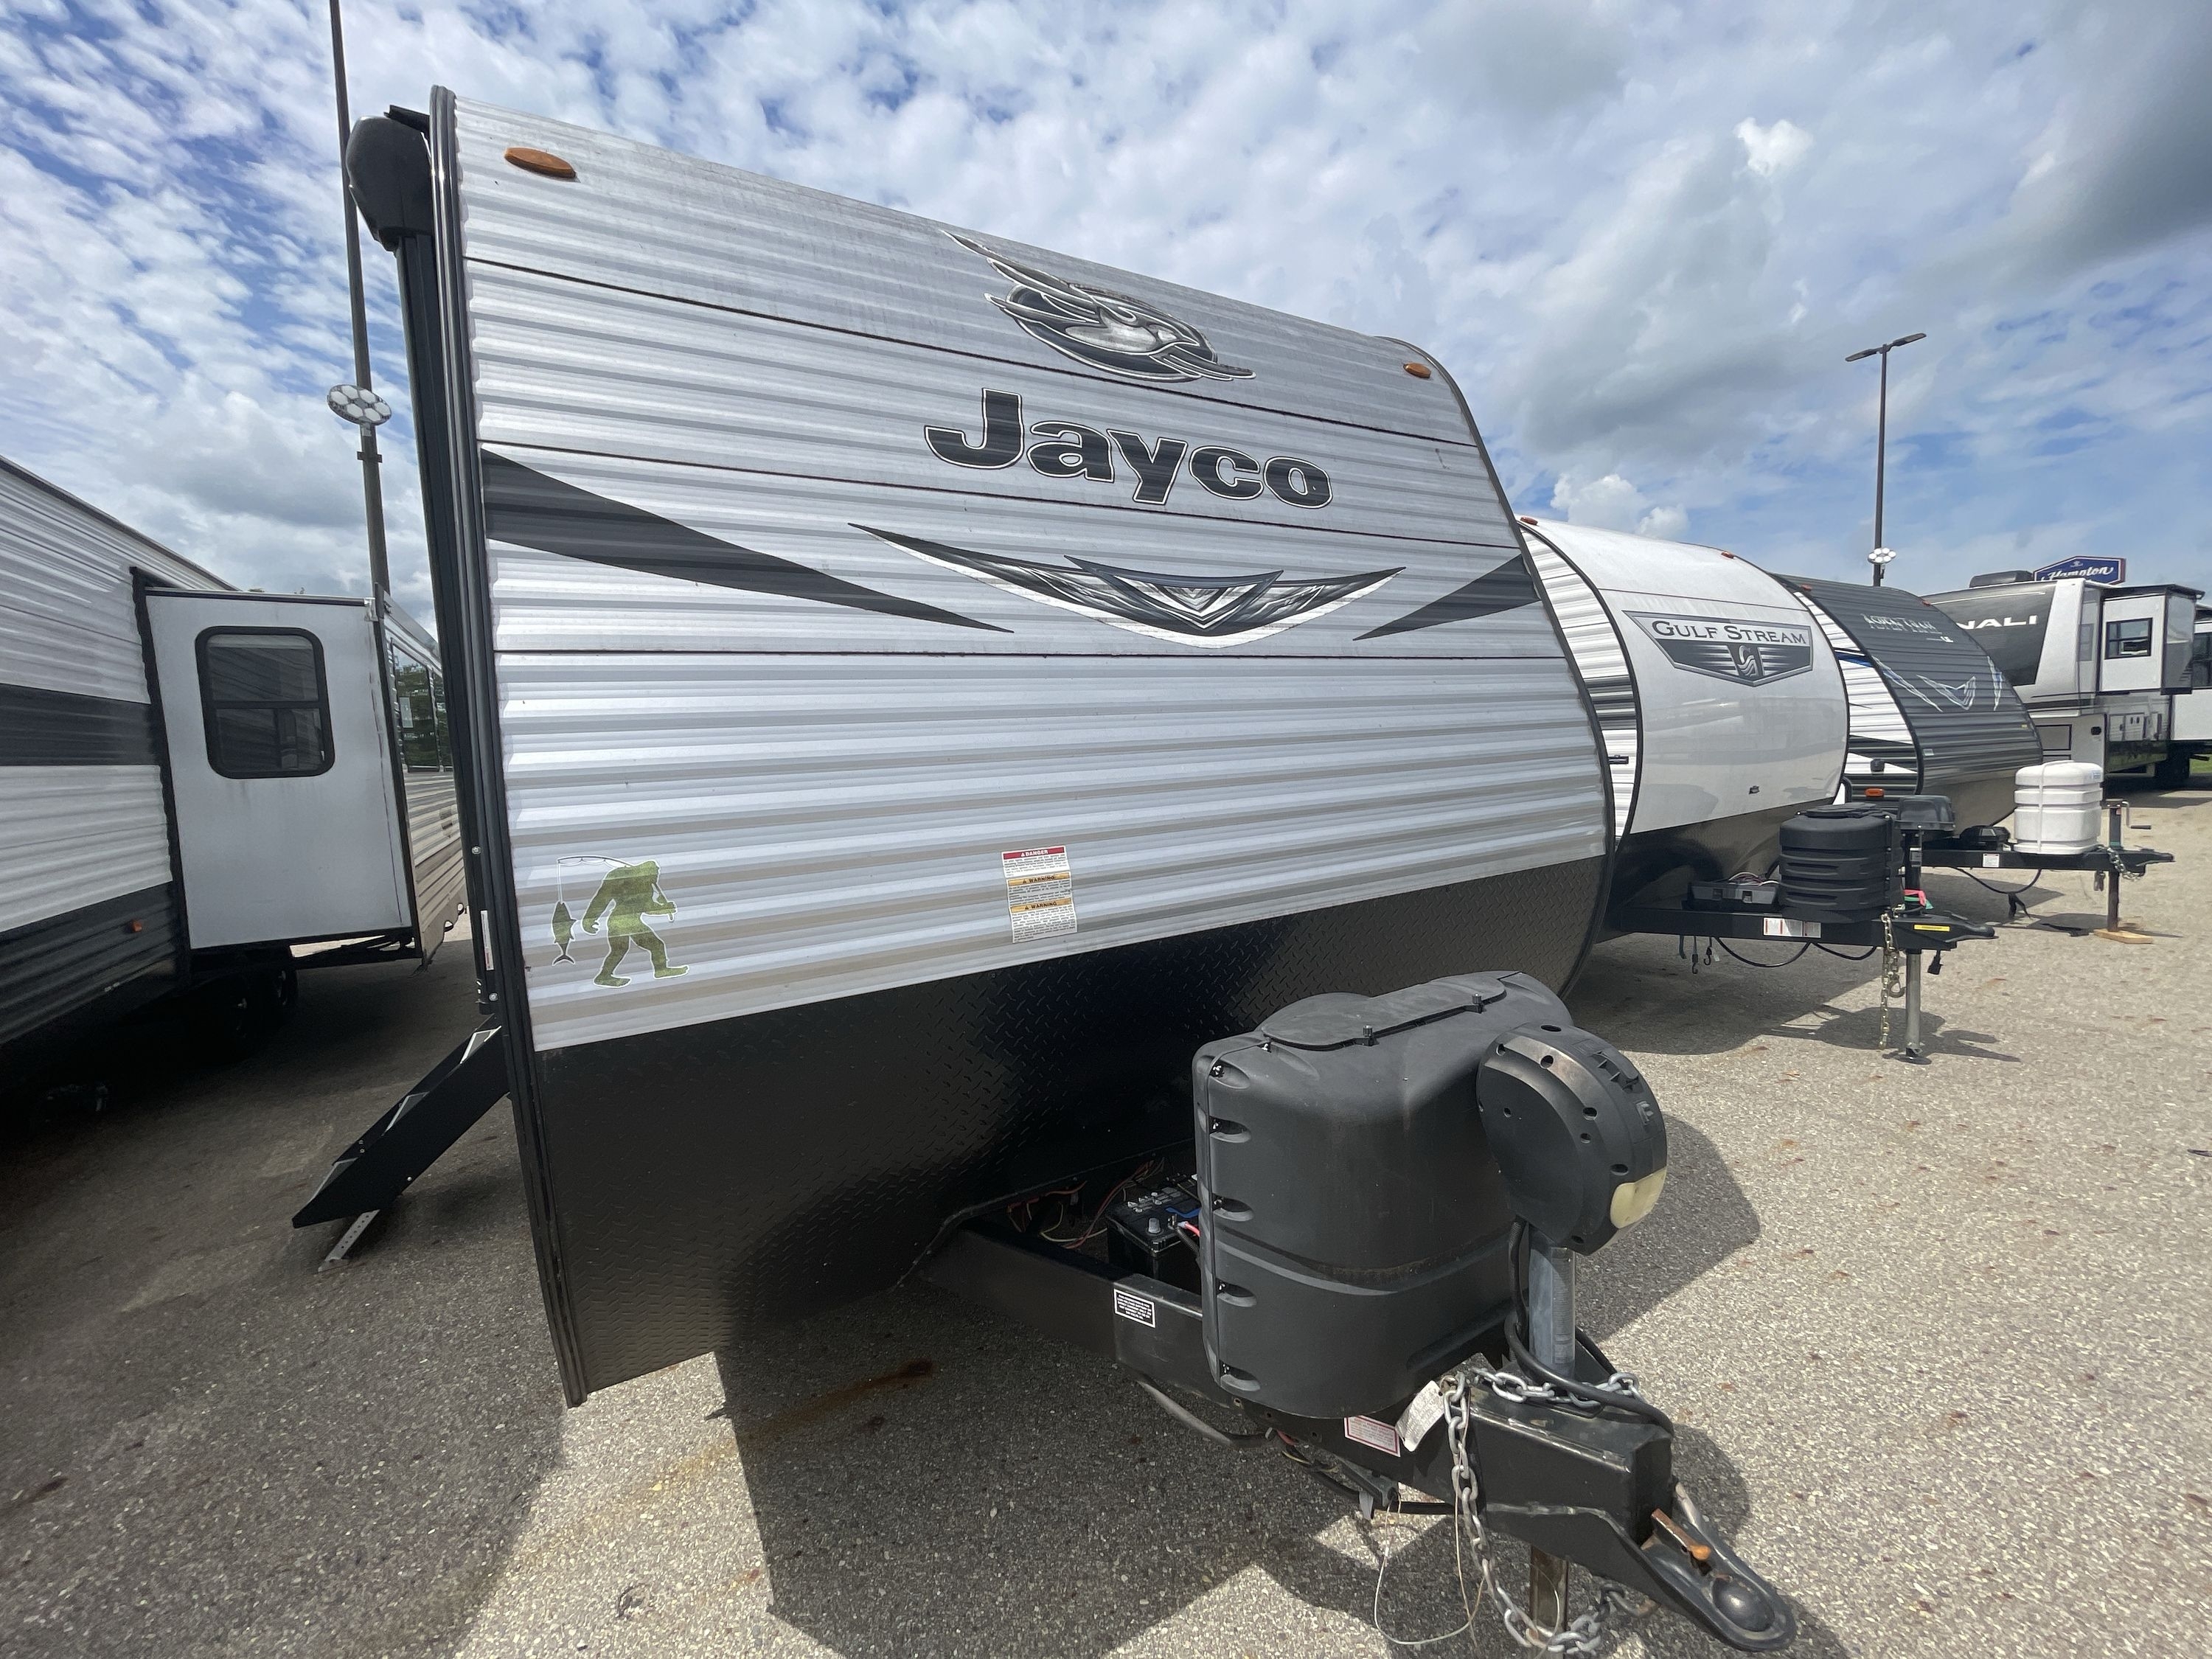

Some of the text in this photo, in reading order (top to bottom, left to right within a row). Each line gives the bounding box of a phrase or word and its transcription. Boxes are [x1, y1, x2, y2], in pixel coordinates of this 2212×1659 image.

[923, 388, 1333, 509] Jayco
[2041, 566, 2114, 581] Hampton
[1652, 620, 1806, 644] GULF STREAM
[1029, 875, 1055, 883] WARNING
[1031, 901, 1057, 909] WARNING
